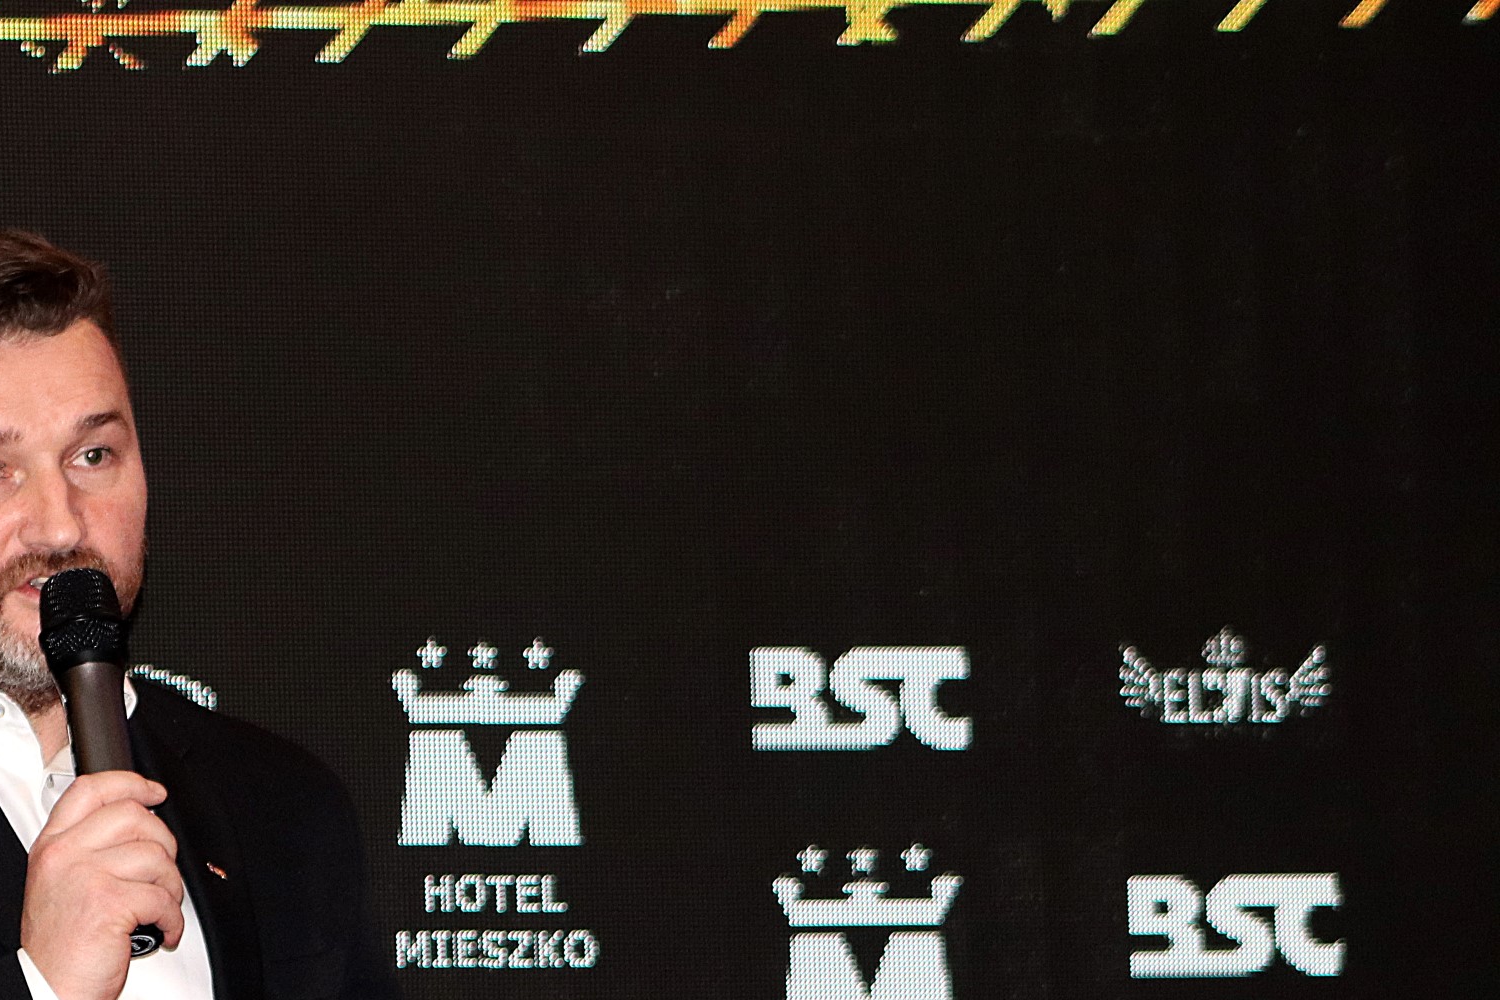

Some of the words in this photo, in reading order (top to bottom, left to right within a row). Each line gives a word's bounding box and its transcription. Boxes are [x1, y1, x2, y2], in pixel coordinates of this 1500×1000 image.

[749, 646, 970, 751] BSC
[424, 874, 567, 914] HOTEL
[1127, 872, 1345, 979] BSC
[395, 929, 598, 969] MIESZKO
